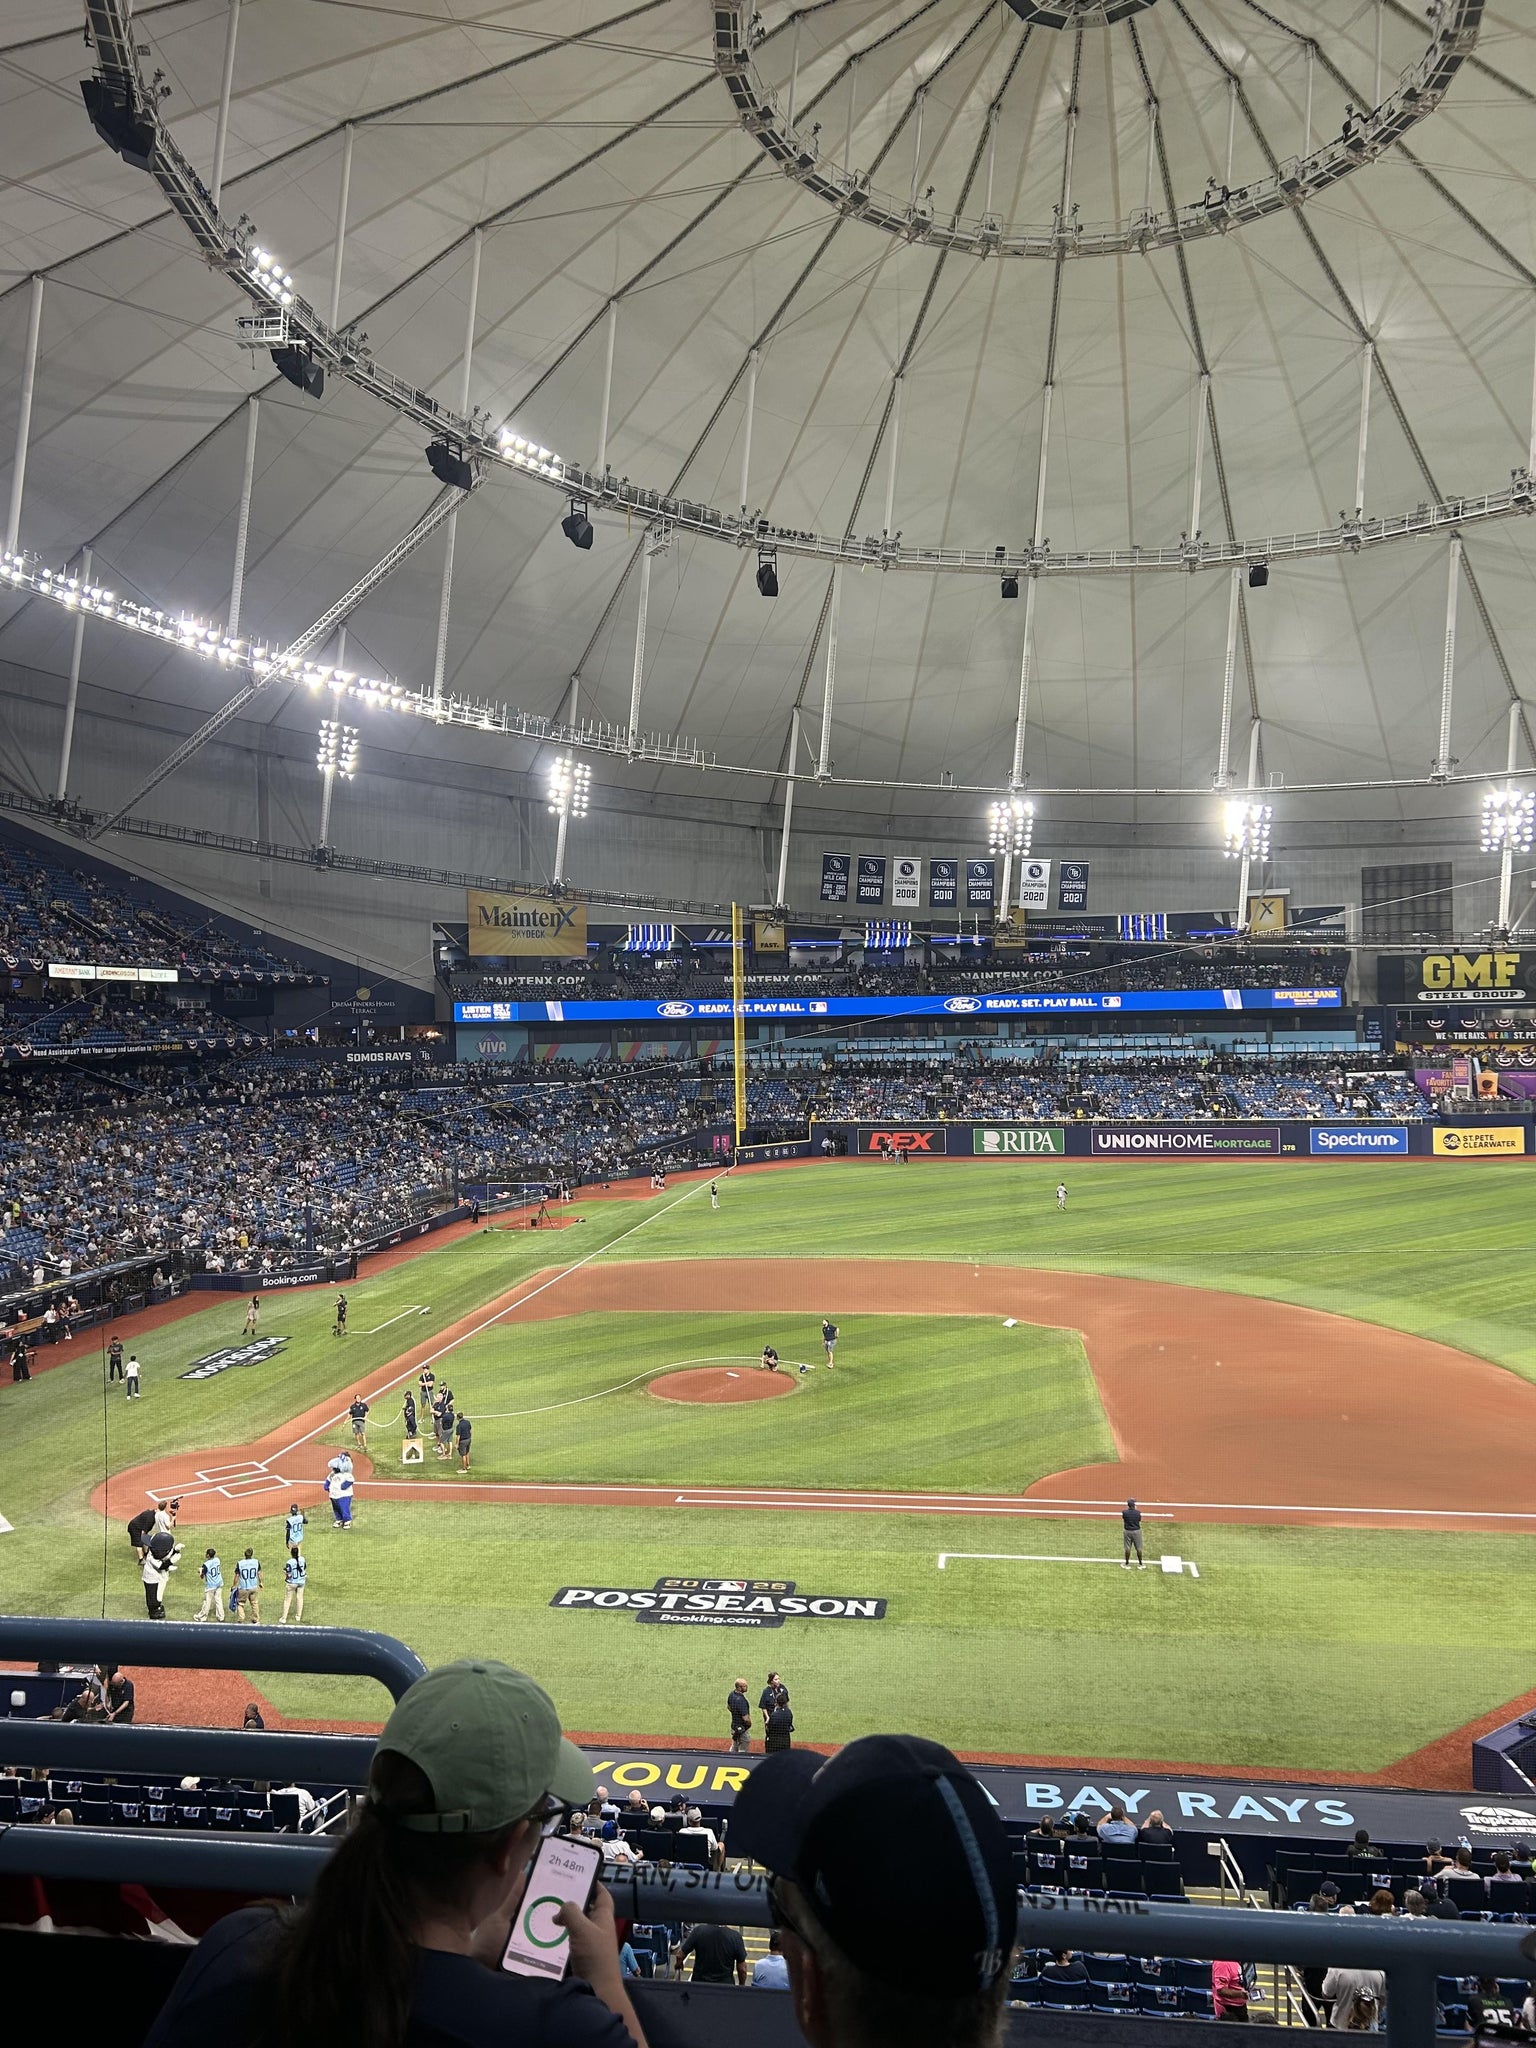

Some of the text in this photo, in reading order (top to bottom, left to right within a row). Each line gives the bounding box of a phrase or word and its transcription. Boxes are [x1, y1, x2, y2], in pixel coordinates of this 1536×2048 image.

[860, 886, 880, 896] 2008
[896, 889, 916, 898] 2008
[934, 890, 952, 900] 2010
[970, 890, 991, 900] 2020
[1024, 892, 1044, 901] 2020
[1063, 893, 1083, 902] 2021
[478, 905, 578, 937] MaintenX
[512, 930, 546, 938] SKYDECK
[1422, 954, 1520, 989] GMF
[1274, 990, 1338, 999] REPUBLIC BANK
[1425, 990, 1518, 1000] STEEL GROUP
[663, 1004, 688, 1015] Ford
[698, 1004, 731, 1013] READY.
[754, 1004, 778, 1012] PLAY
[779, 1003, 805, 1012] BALL.
[950, 998, 1098, 1010] Ford READY. SET. PLAY BALL.
[462, 1006, 492, 1014] LISTEN
[1435, 1032, 1446, 1040] WE
[1453, 1032, 1468, 1040] THE
[1468, 1032, 1487, 1040] RAYS.
[48, 1048, 80, 1056] Assistance?
[478, 1041, 506, 1053] VIVA
[346, 1052, 384, 1062] SOMOS
[386, 1052, 412, 1060] RAYS
[868, 1132, 934, 1150] DEX
[1001, 1130, 1057, 1152] RIPA
[1318, 1132, 1394, 1149] Spectrum
[262, 1274, 318, 1286] Booking.com
[242, 1568, 256, 1580] 00
[558, 1589, 878, 1617] POSTSEASON
[660, 1614, 761, 1625] Booking.com
[1024, 1783, 1150, 1814] BAY
[1176, 1791, 1354, 1826] RAYS
[548, 1854, 585, 1873] 2h 48m
